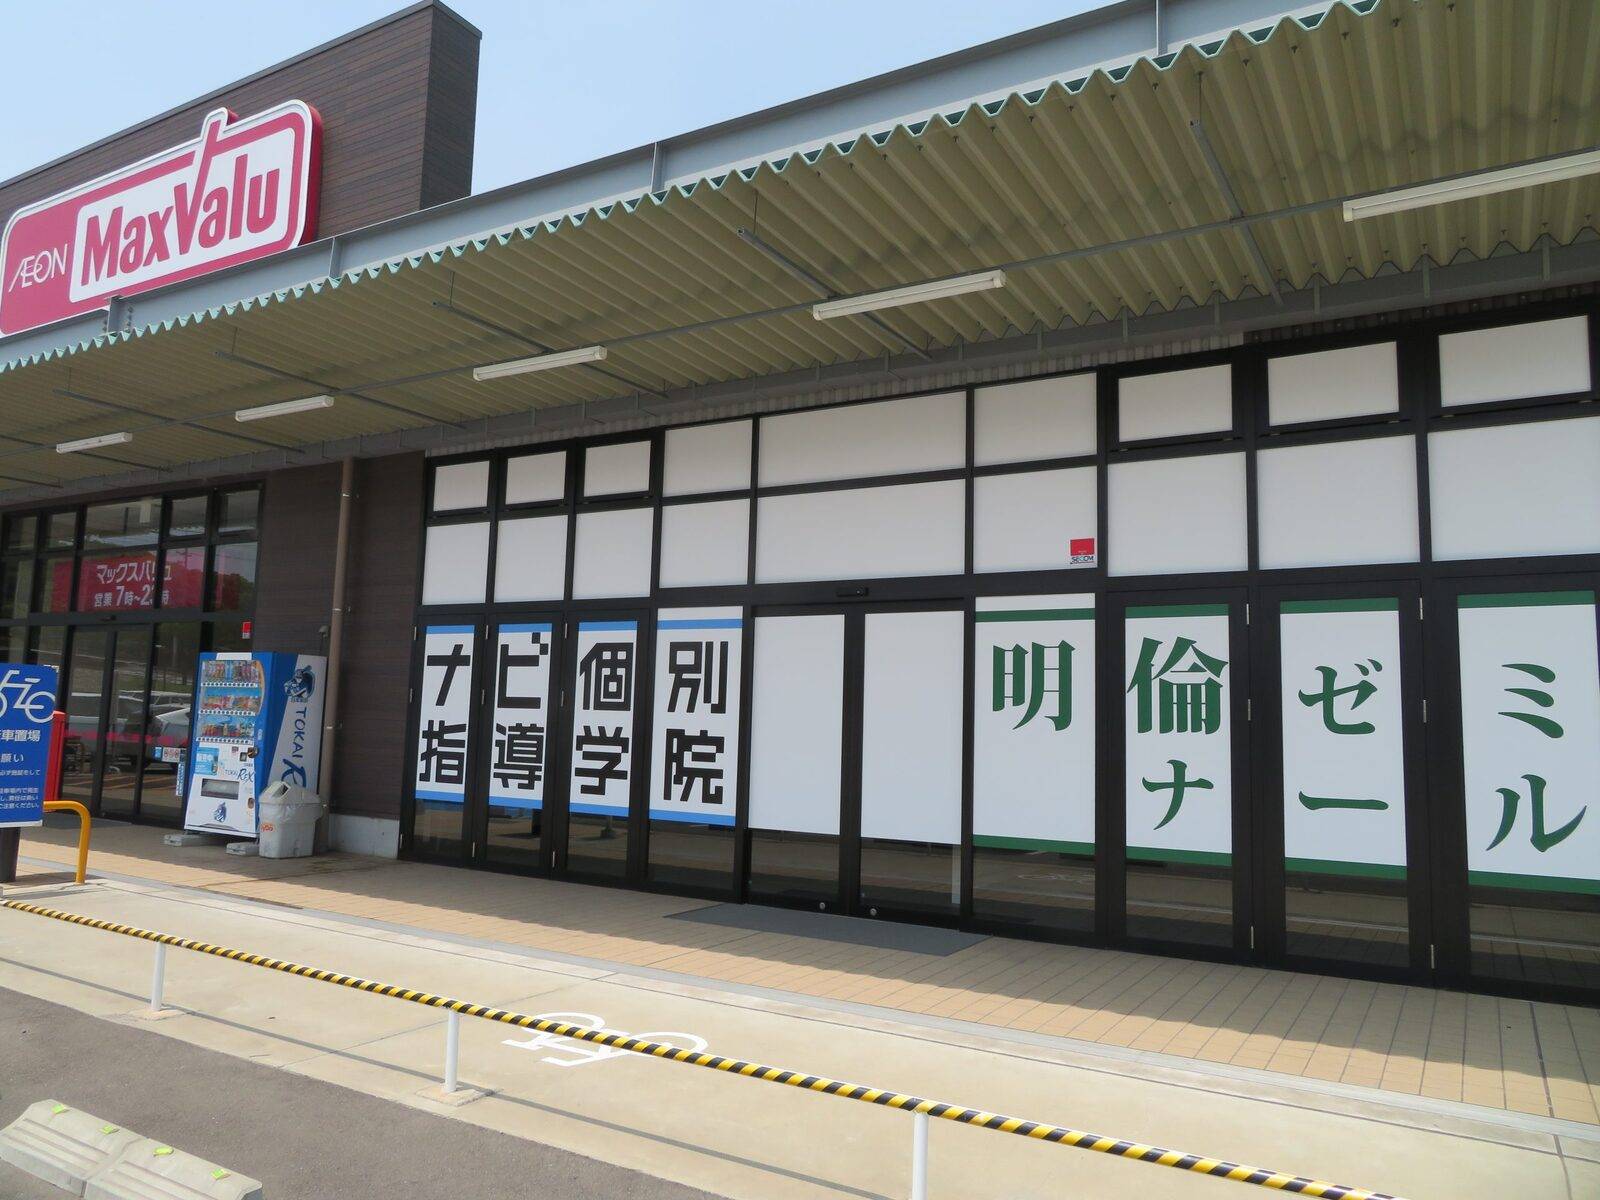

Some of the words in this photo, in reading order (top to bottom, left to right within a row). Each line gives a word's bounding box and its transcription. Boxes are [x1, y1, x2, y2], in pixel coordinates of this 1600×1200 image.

[80, 120, 280, 287] MaxValu
[426, 632, 729, 714] ナビ個別
[992, 636, 1565, 740] 明倫ゼミ
[0, 729, 41, 742] 車置場
[292, 706, 307, 759] TOKAI
[419, 719, 725, 804] 指導学院
[1142, 759, 1587, 853] ナール
